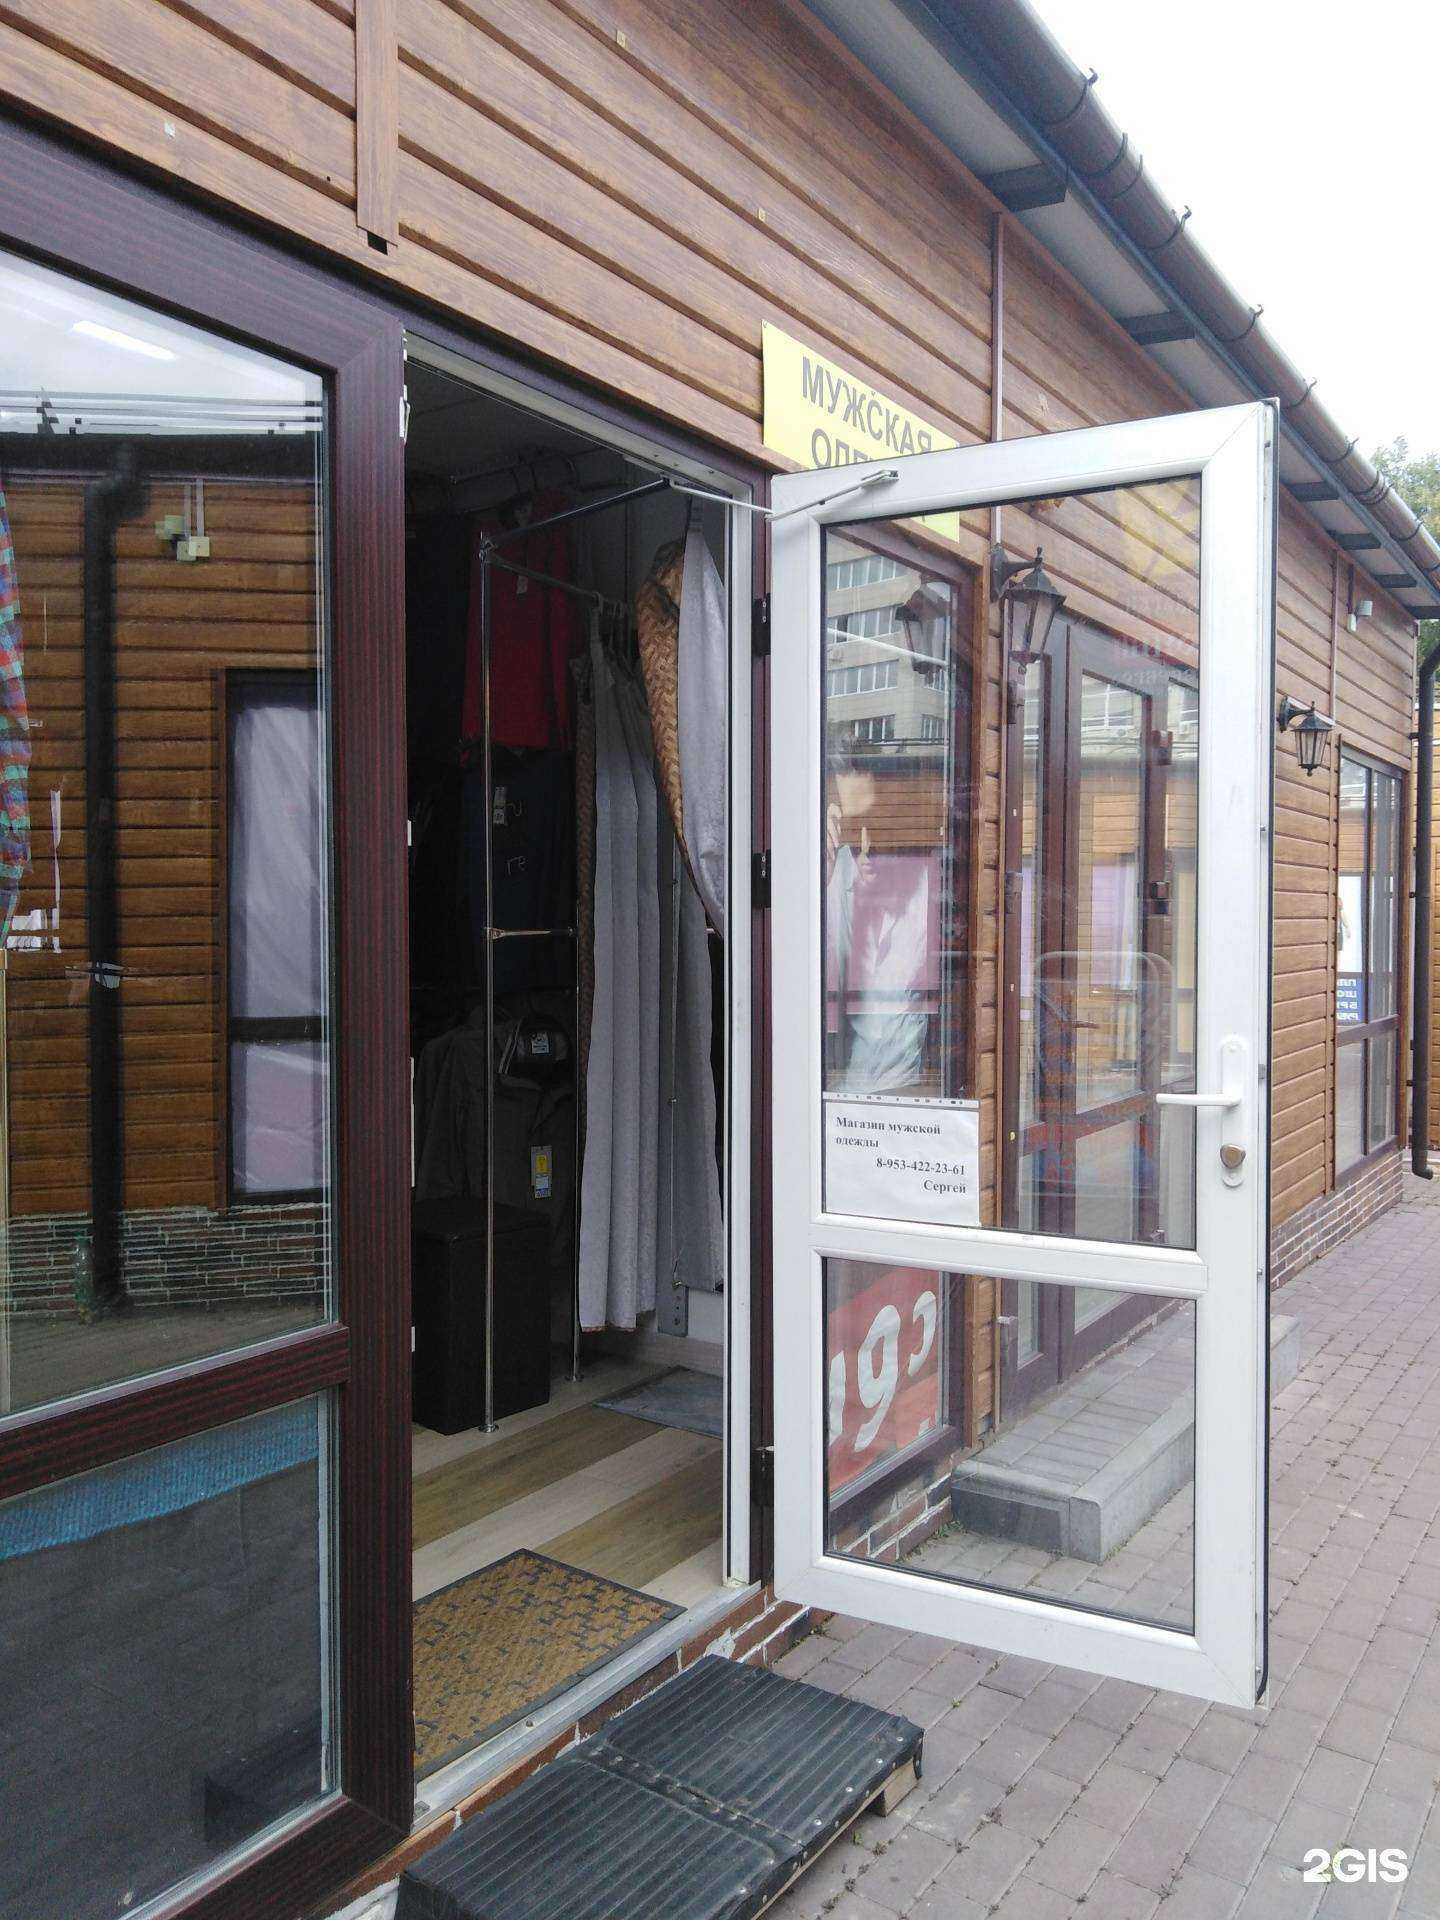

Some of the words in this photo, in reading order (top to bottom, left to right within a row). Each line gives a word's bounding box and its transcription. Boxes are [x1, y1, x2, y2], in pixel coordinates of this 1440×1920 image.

[802, 356, 932, 455] МУЖСКАЯ
[836, 1117, 885, 1131] Магазин
[888, 1122, 941, 1135] мужской
[836, 1136, 879, 1148] одежды
[876, 1158, 965, 1176] 8-953-422-23-61
[923, 1179, 966, 1195] Сергей
